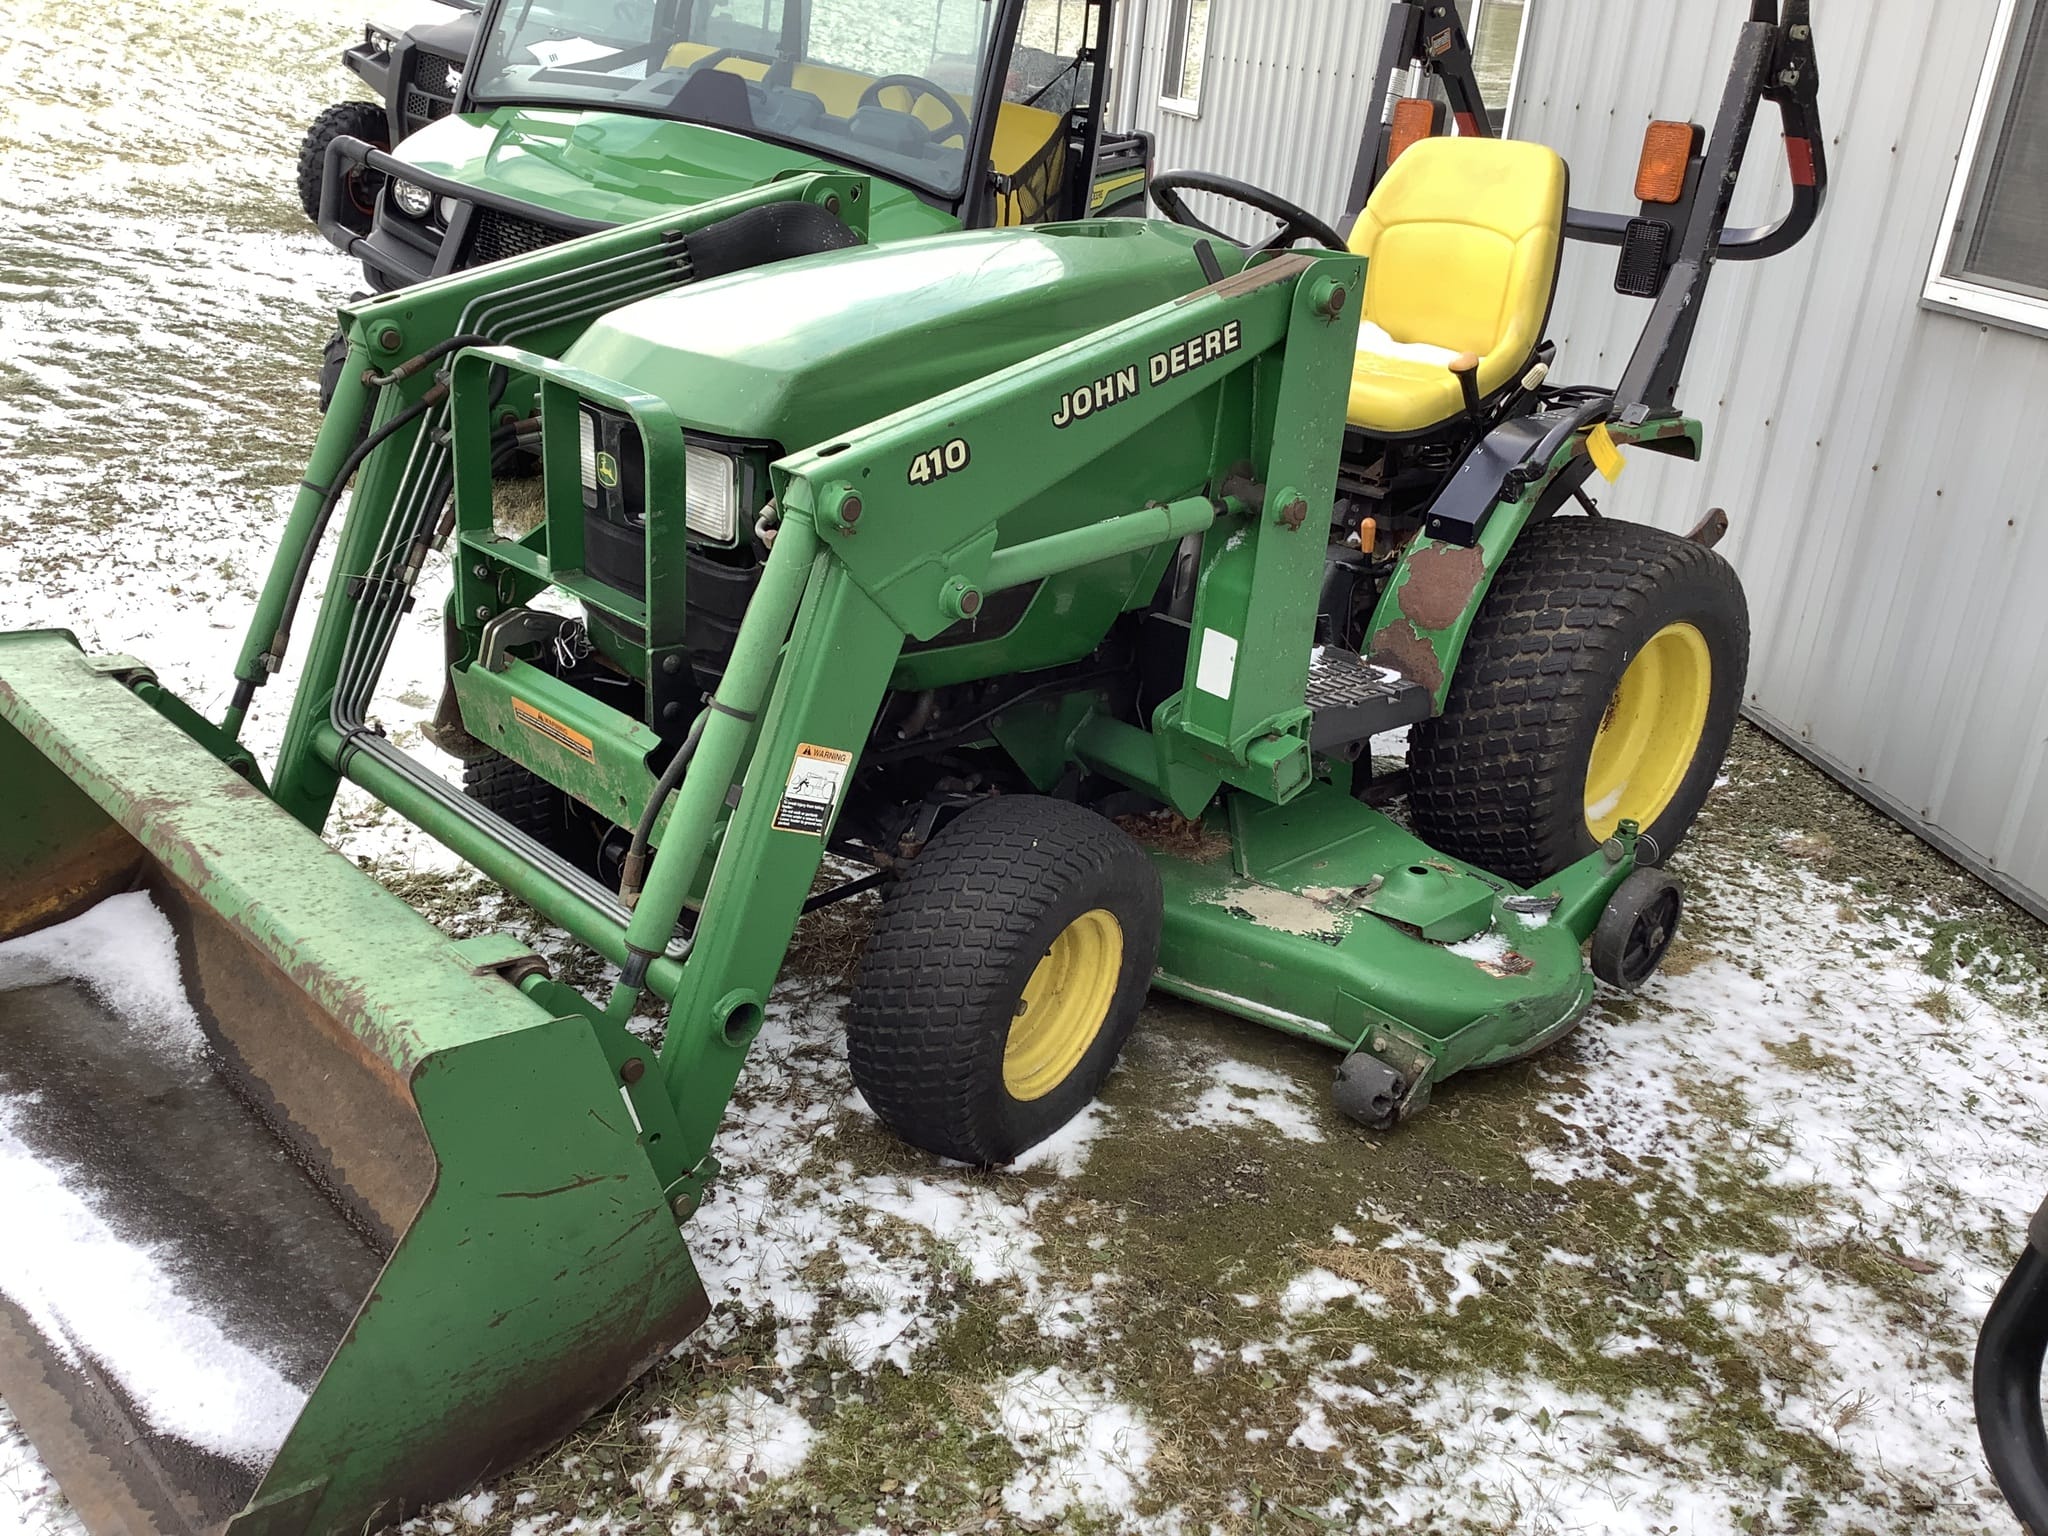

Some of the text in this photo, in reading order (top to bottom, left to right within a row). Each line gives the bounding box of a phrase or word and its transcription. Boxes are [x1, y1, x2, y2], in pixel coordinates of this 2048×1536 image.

[1052, 320, 1242, 428] JOHN DEERE
[908, 438, 971, 485] 410
[813, 748, 847, 762] WARNING
